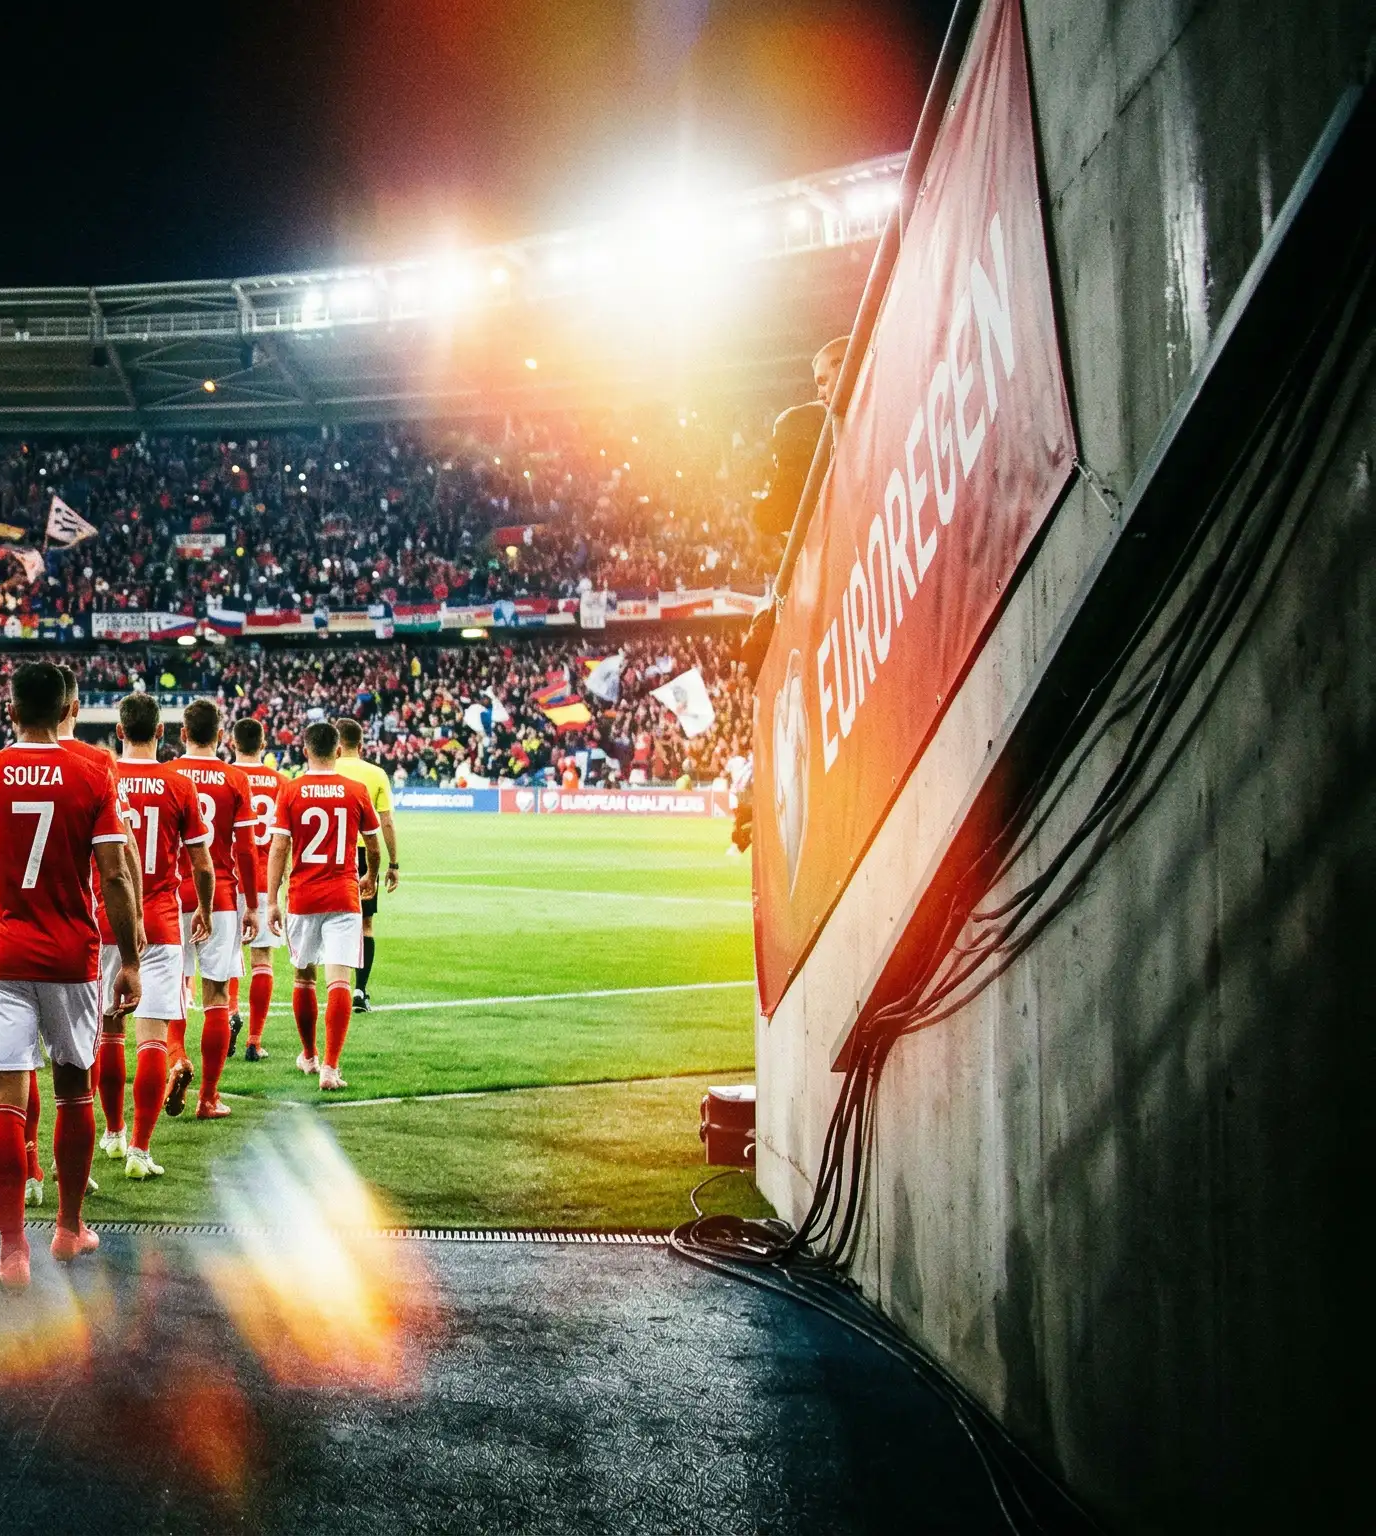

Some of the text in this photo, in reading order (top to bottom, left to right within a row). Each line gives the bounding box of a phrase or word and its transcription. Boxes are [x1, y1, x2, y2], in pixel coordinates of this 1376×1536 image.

[817, 211, 1015, 775] EUROREGEN
[3, 766, 63, 786] SOUZA
[12, 801, 54, 889] 7
[301, 806, 347, 865] 21
